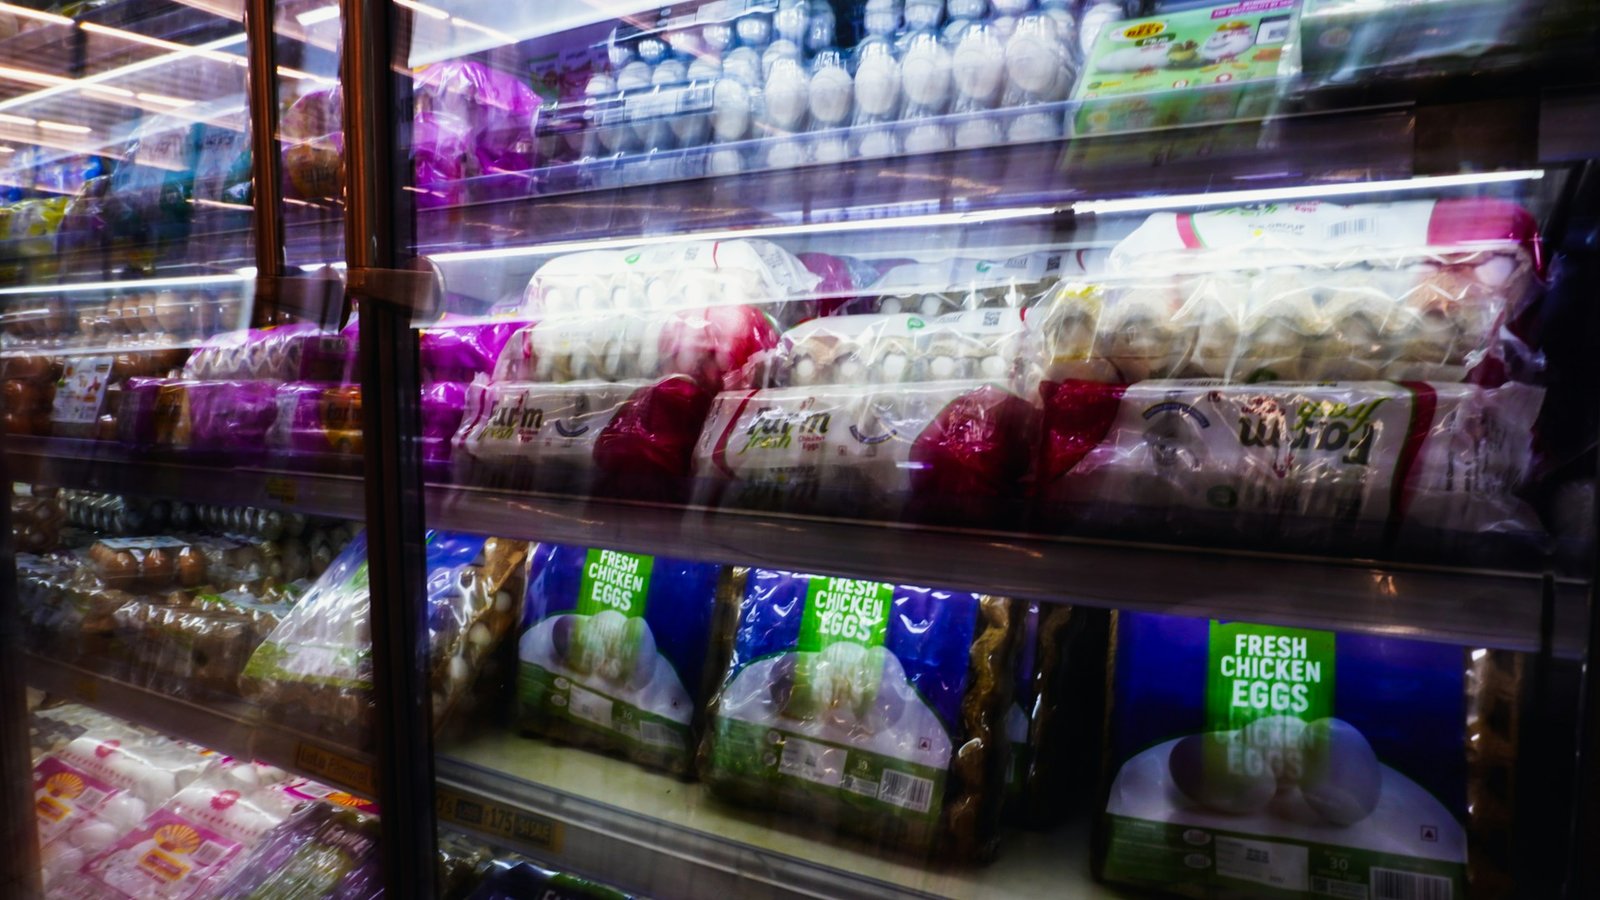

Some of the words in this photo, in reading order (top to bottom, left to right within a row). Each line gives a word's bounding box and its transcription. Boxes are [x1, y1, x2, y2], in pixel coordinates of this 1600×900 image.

[599, 549, 639, 574] FRESH
[588, 563, 644, 593] CHICKEN
[828, 577, 879, 597] FRESH
[591, 581, 633, 612] EGGS
[814, 590, 884, 619] CHICKEN
[819, 614, 872, 641] EGGS
[1234, 633, 1307, 660] FRESH
[1220, 654, 1321, 683] CHICKEN
[1232, 680, 1309, 713] EGGS
[1329, 857, 1349, 871] 30
